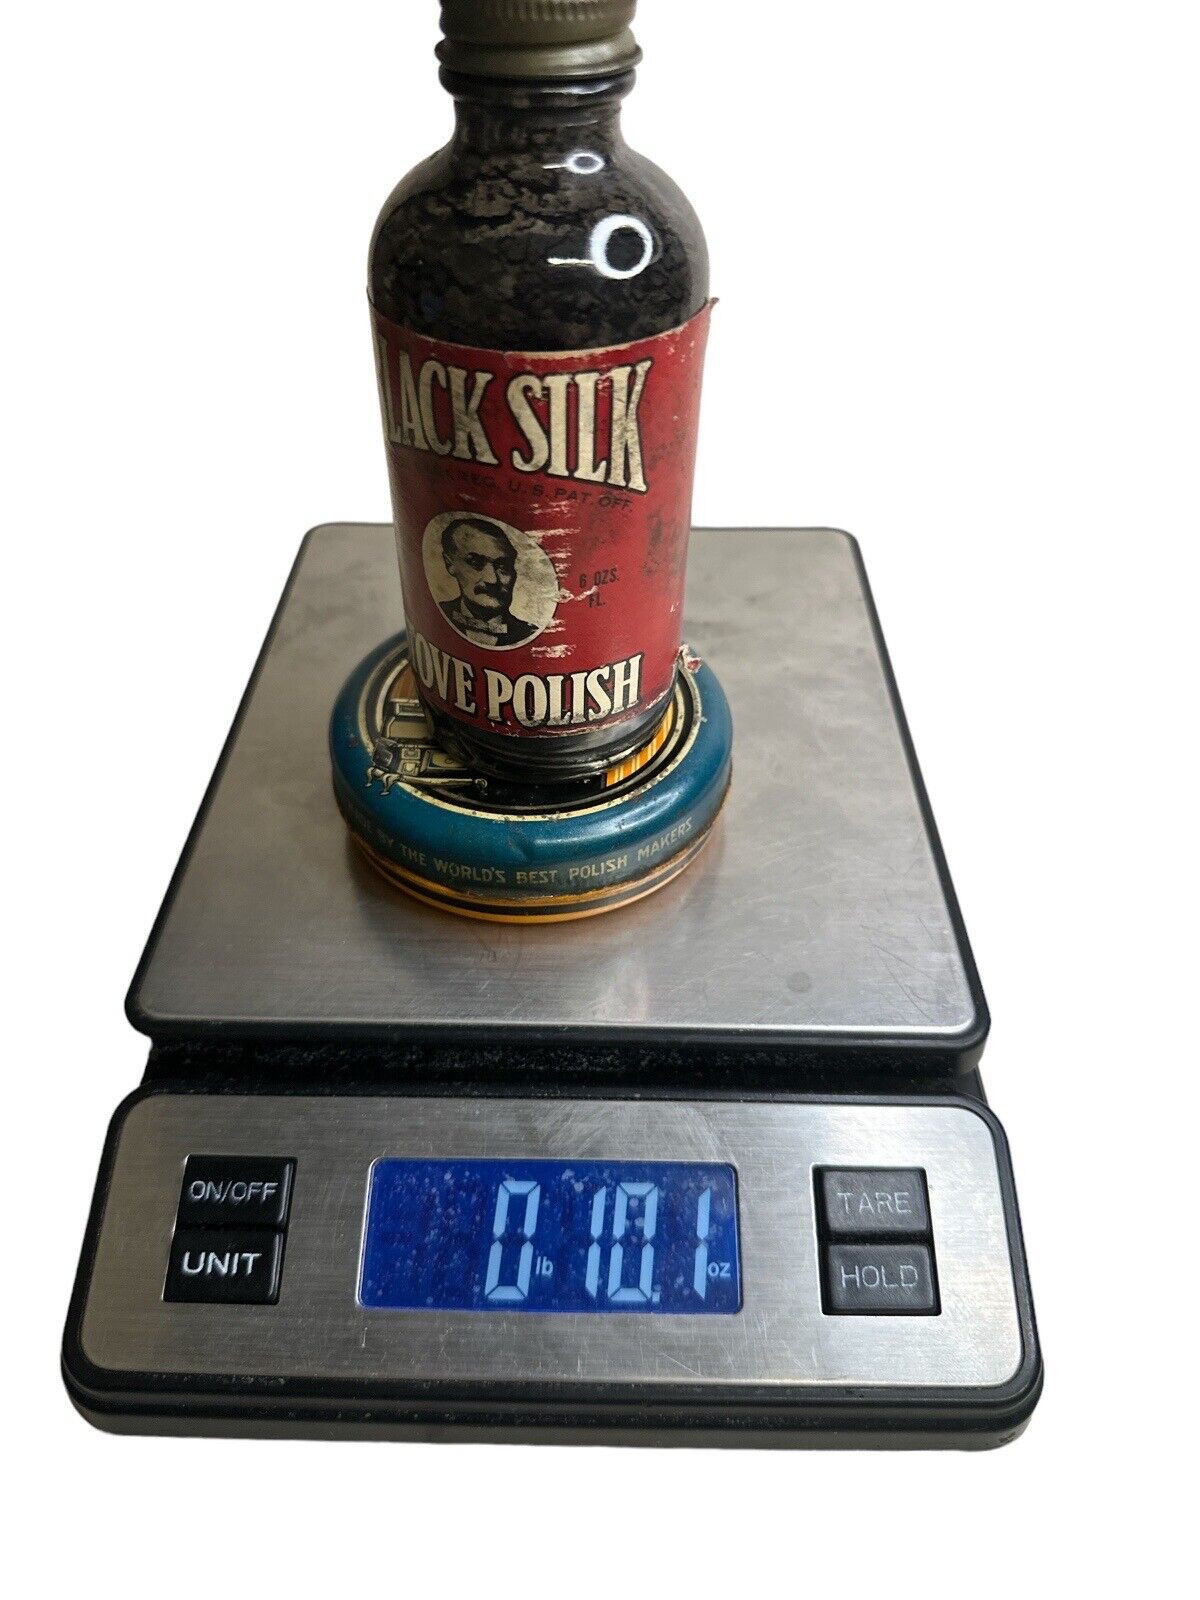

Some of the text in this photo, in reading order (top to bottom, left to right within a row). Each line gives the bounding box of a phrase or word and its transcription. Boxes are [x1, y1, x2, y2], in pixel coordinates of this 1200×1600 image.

[507, 358, 654, 493] SILK
[579, 567, 620, 588] 6 OZS.
[484, 654, 643, 727] POLISH
[400, 844, 427, 867] THE
[433, 858, 506, 883] WORLD'S
[516, 869, 558, 884] BEST
[569, 855, 629, 881] POLISH
[637, 816, 692, 861] MAKERS
[190, 1180, 278, 1202] ON/OFF
[837, 1191, 912, 1214] TARE
[485, 1181, 731, 1303] 0 lb 10.1 oz
[183, 1251, 262, 1276] UNIT
[840, 1265, 919, 1288] HOLD
